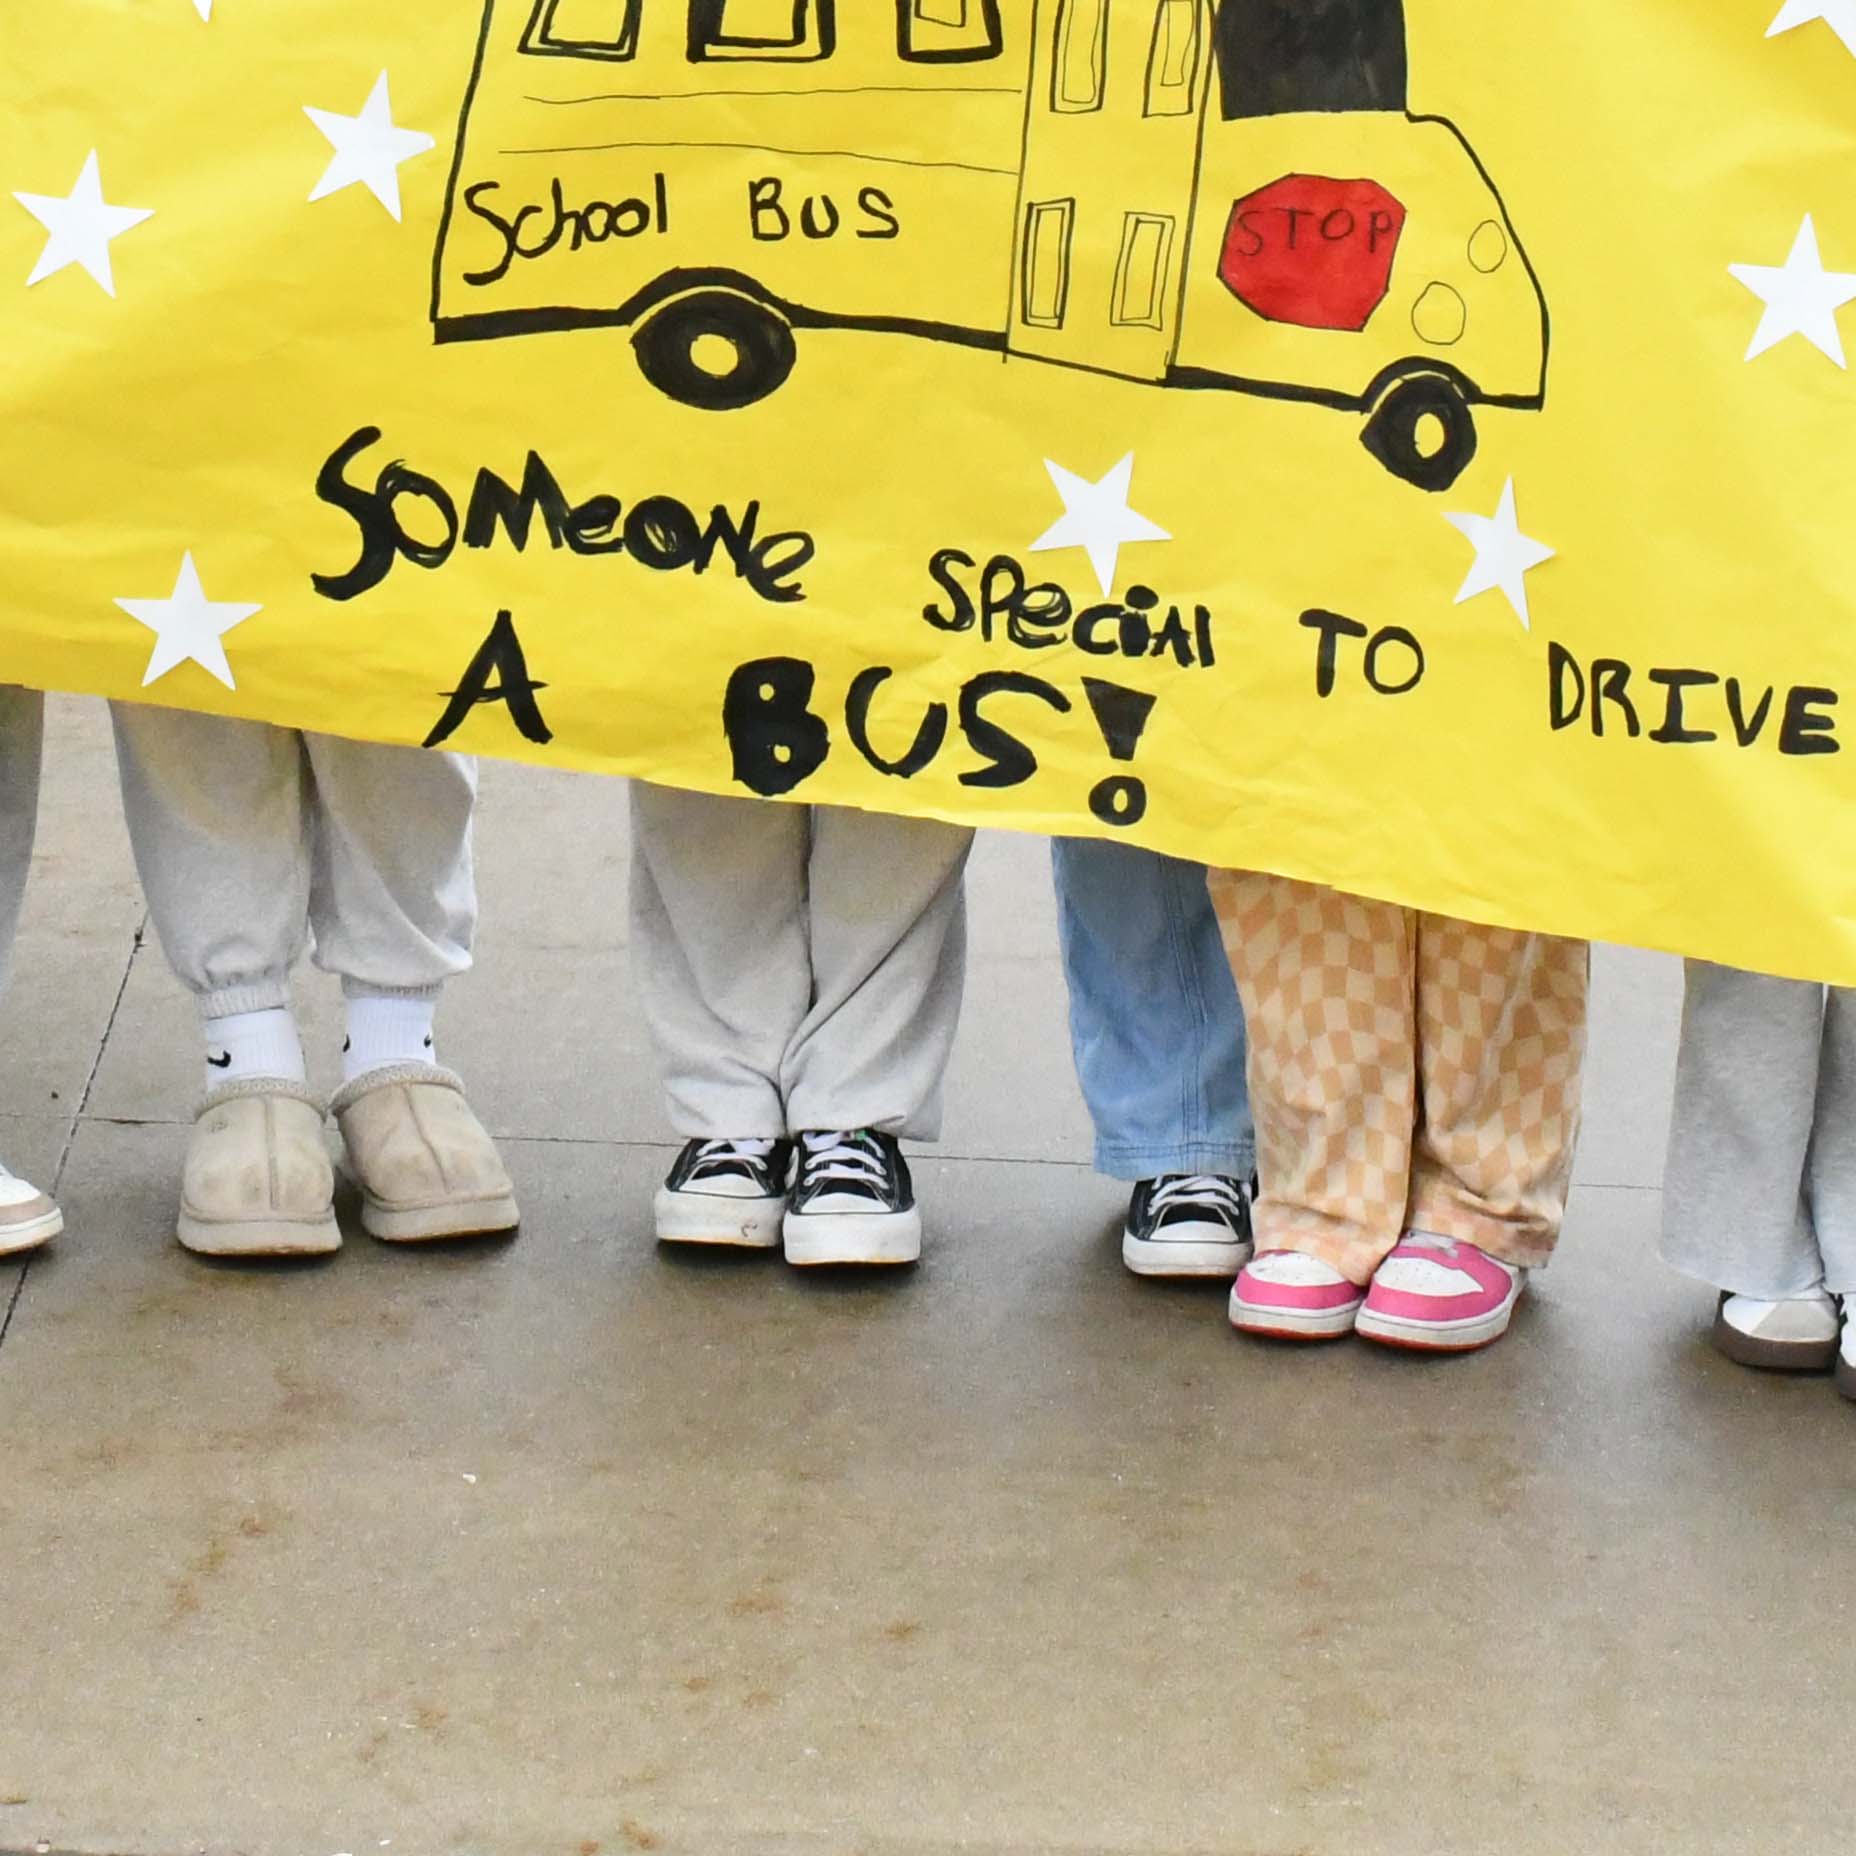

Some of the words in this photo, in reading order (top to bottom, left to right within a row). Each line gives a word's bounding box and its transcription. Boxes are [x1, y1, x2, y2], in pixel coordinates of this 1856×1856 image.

[463, 172, 668, 286] School
[748, 176, 900, 243] BUS
[1237, 206, 1393, 256] STOP
[421, 608, 554, 748] A
[721, 656, 1158, 826] BUS!
[1297, 608, 1425, 699] TO
[1547, 640, 1841, 756] DRIVE
